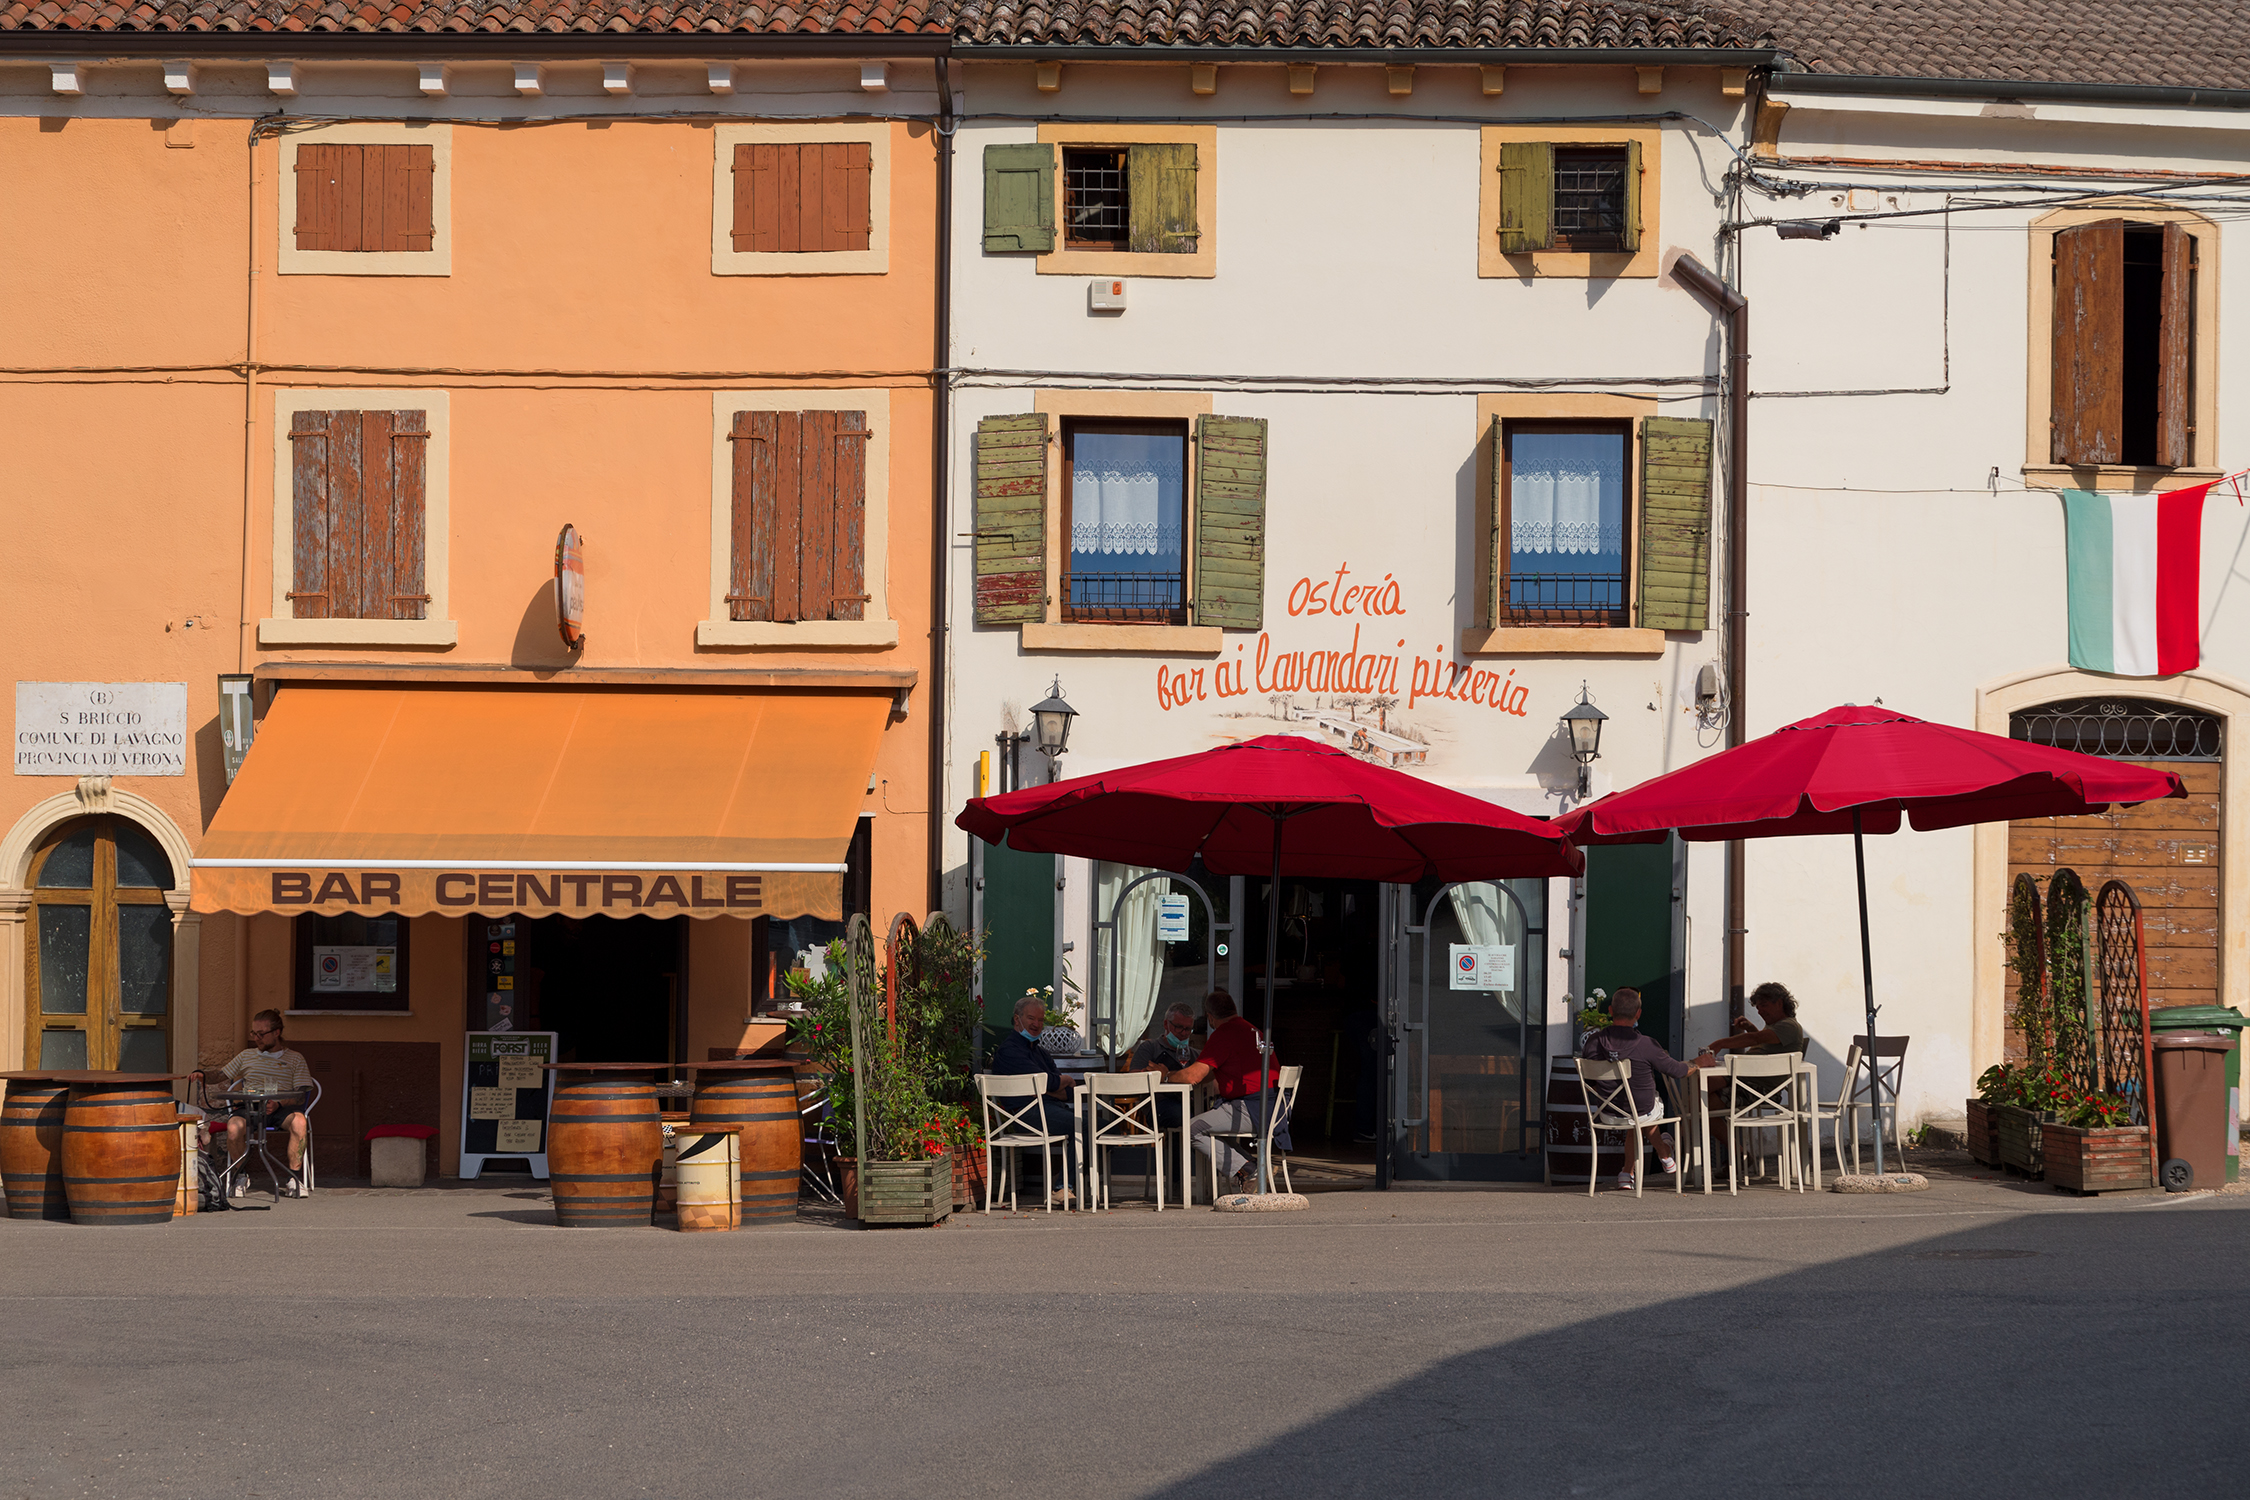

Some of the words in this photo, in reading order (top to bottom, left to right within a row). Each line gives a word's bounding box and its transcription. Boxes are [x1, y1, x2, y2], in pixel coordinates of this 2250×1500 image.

[1287, 561, 1406, 617] osteria
[1157, 664, 1207, 711] bar
[1215, 644, 1248, 698] ai
[1255, 623, 1404, 695] lavandari
[1408, 644, 1530, 717] pizzeria
[79, 712, 142, 725] BRICCIO
[222, 681, 249, 751] T
[19, 732, 83, 745] COMUNE
[91, 732, 106, 745] DI
[114, 732, 183, 745] LAVAGNO
[18, 752, 98, 765] PROVINCIA
[103, 752, 117, 765] DI
[122, 752, 183, 766] VERONA
[272, 872, 400, 905] BAR
[436, 872, 762, 907] CENTRALE
[493, 1043, 527, 1054] FORST
